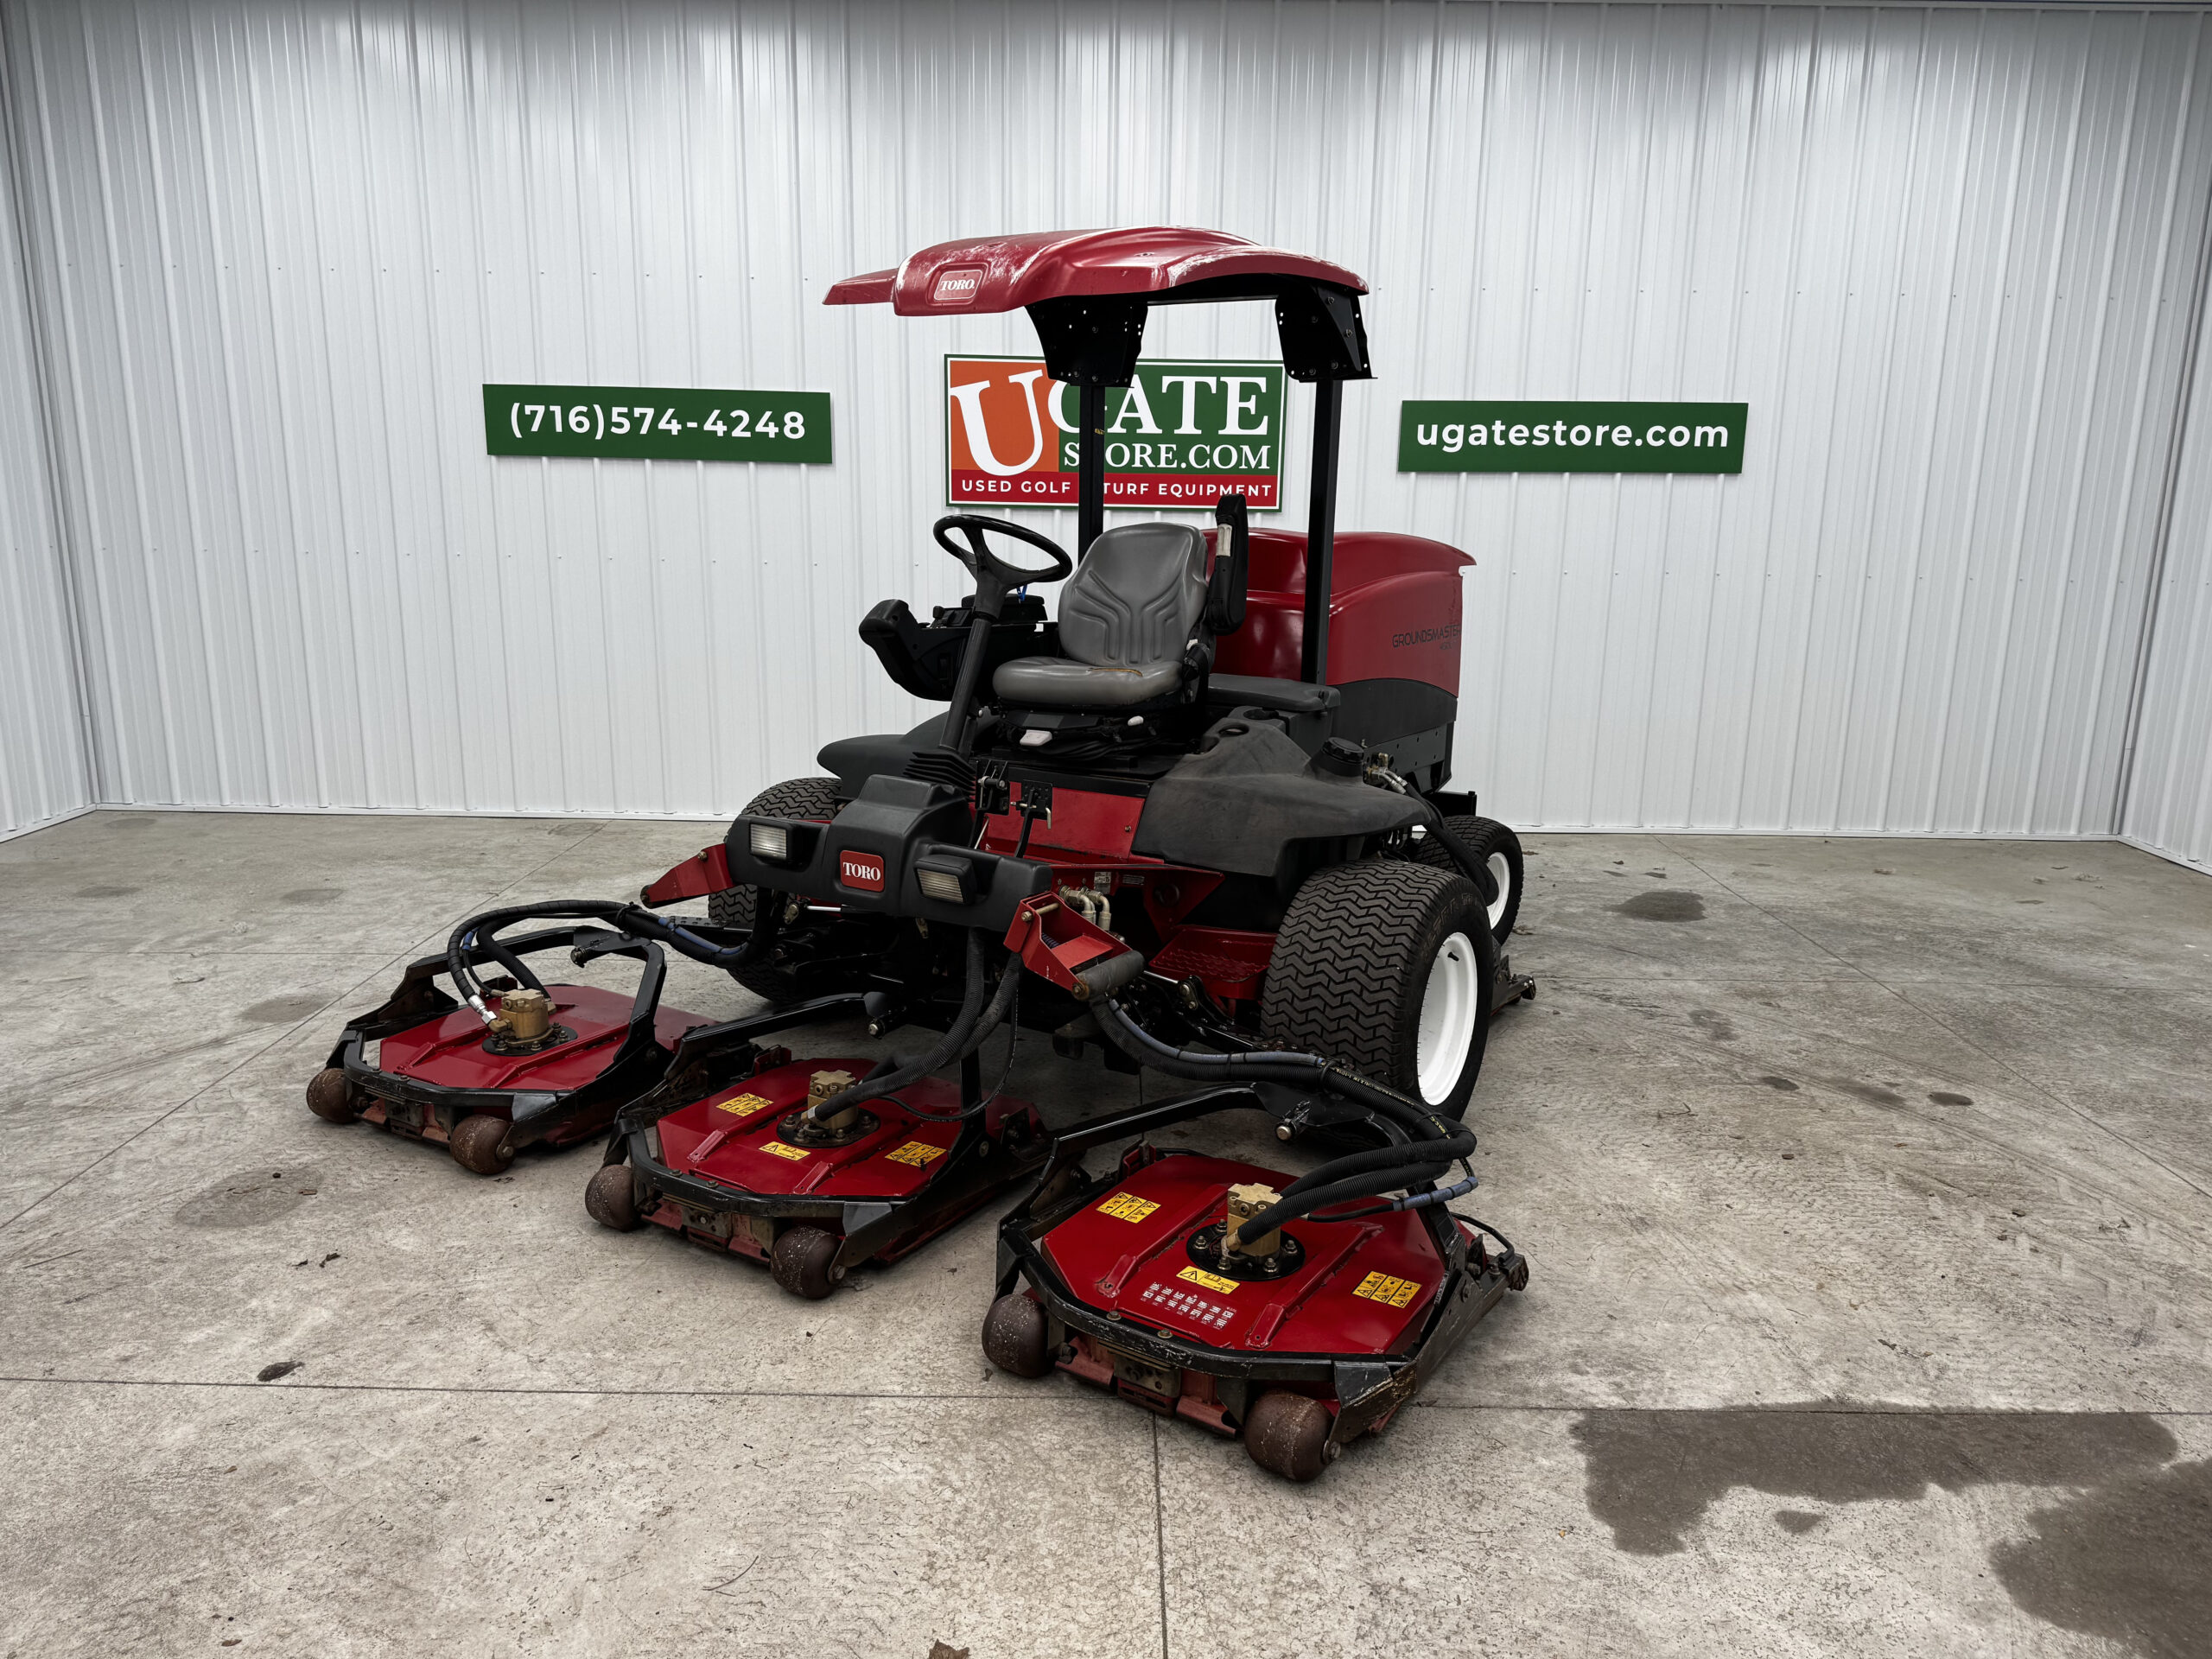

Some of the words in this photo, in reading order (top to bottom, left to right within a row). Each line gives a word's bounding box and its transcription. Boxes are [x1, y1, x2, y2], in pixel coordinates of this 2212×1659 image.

[939, 279, 975, 291] TORO
[510, 402, 806, 440] (716)574-4248
[1416, 420, 1729, 453] ugatestore.com
[1064, 442, 1271, 469] SORE.COM
[962, 480, 1012, 493] USED
[1020, 480, 1071, 493] GOLF
[1103, 482, 1149, 495] TURF
[1158, 483, 1272, 498] EQUIPMENT
[842, 861, 881, 881] TORO
